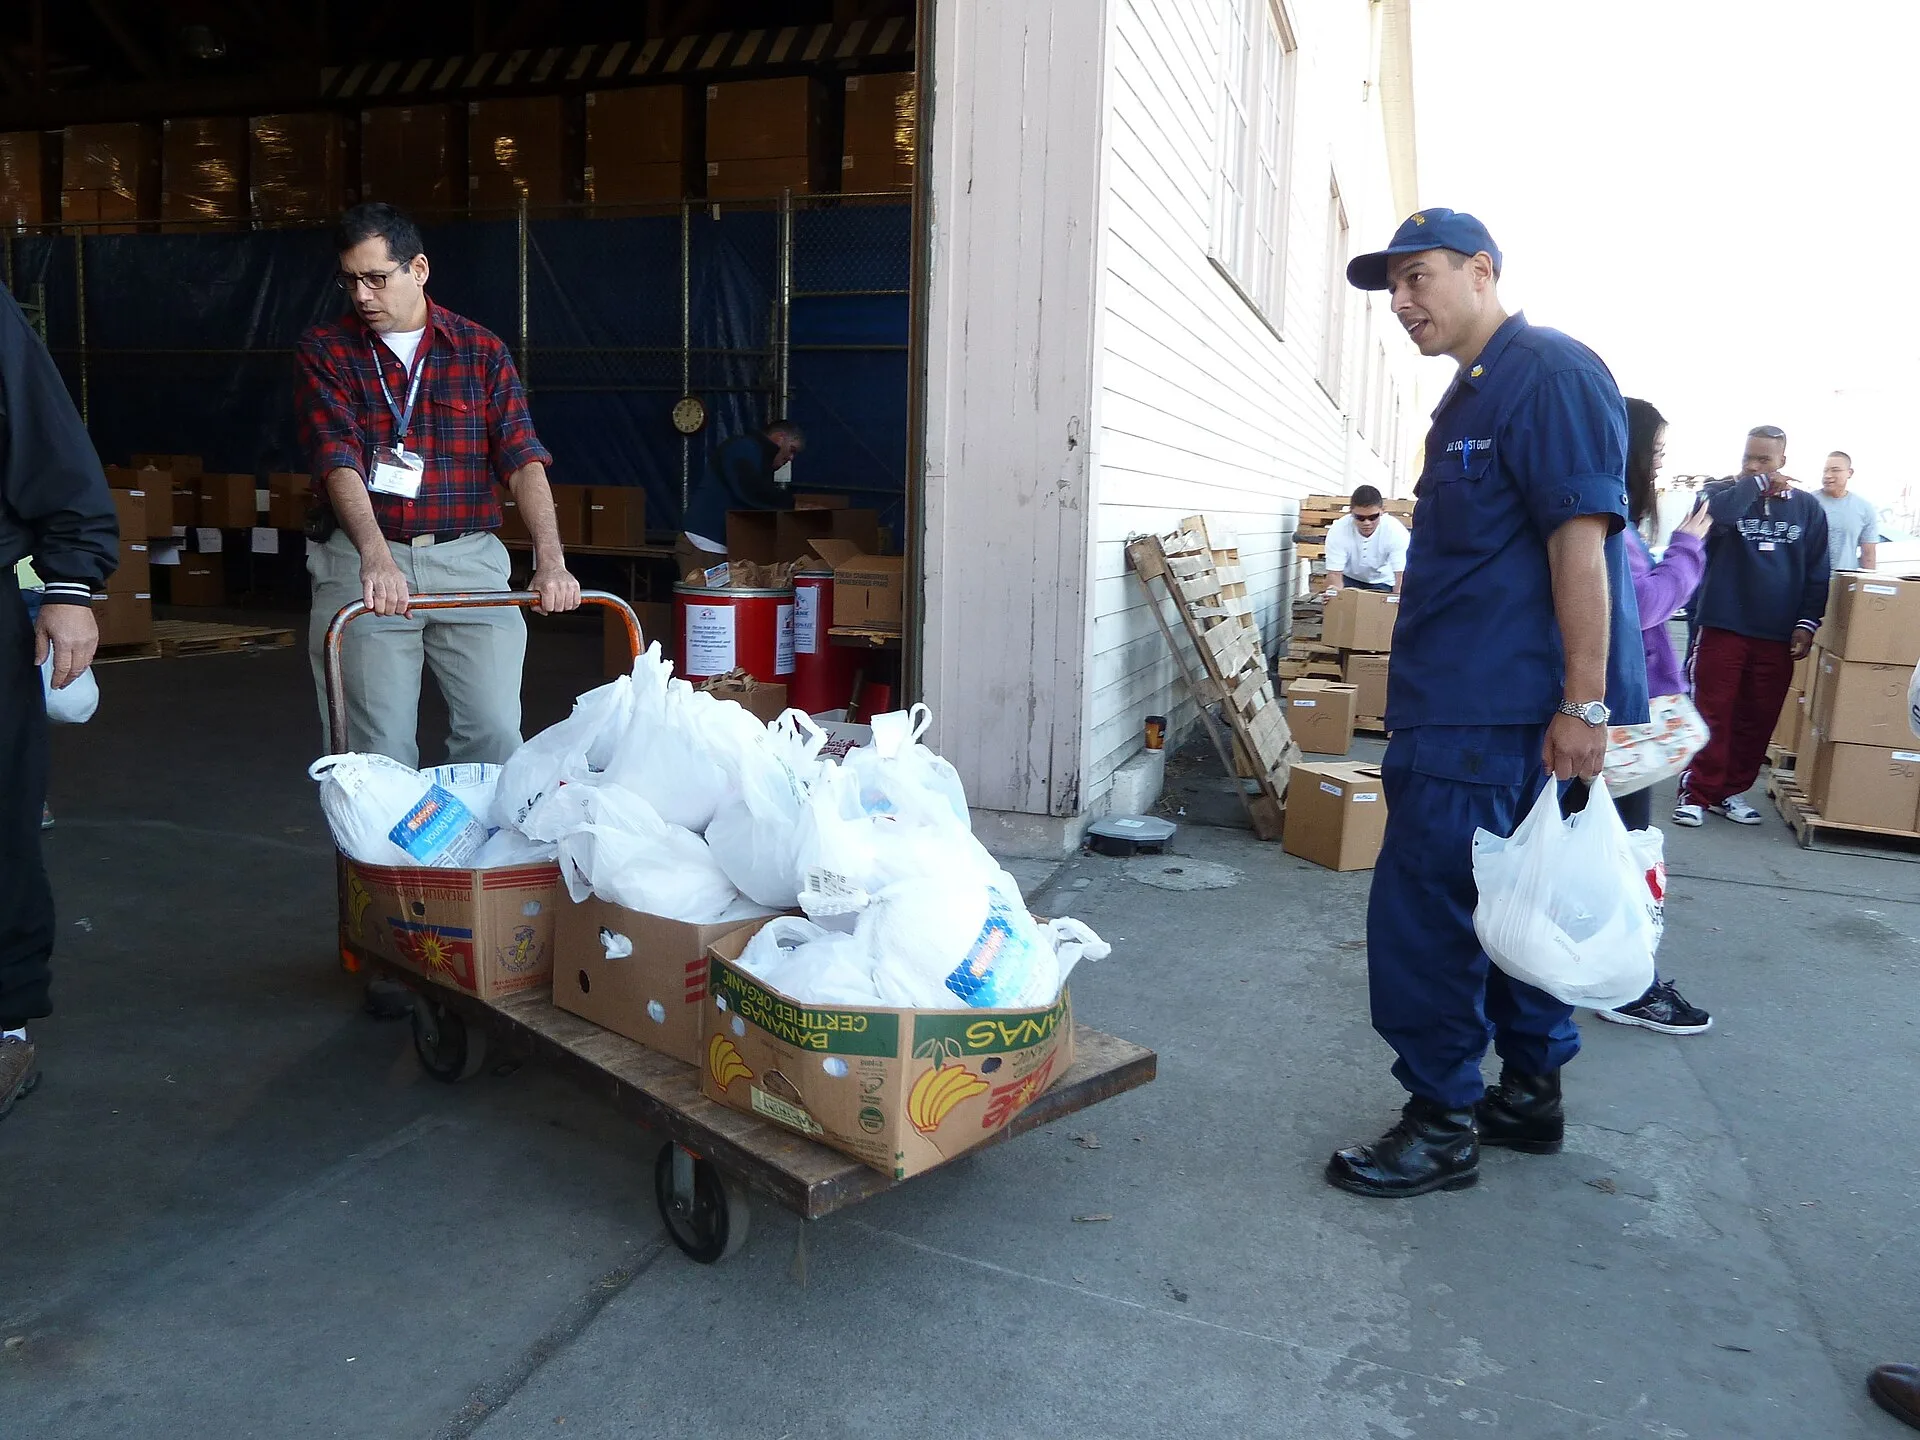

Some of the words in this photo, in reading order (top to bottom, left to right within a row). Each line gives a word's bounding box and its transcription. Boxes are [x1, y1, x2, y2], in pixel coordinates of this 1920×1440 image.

[1455, 440, 1476, 451] COST
[424, 820, 449, 846] young
[424, 887, 472, 902] PREMIUM
[722, 969, 773, 1010] ORGANIC
[740, 1000, 829, 1049] BANANAS
[774, 1003, 868, 1033] CERTIFIED
